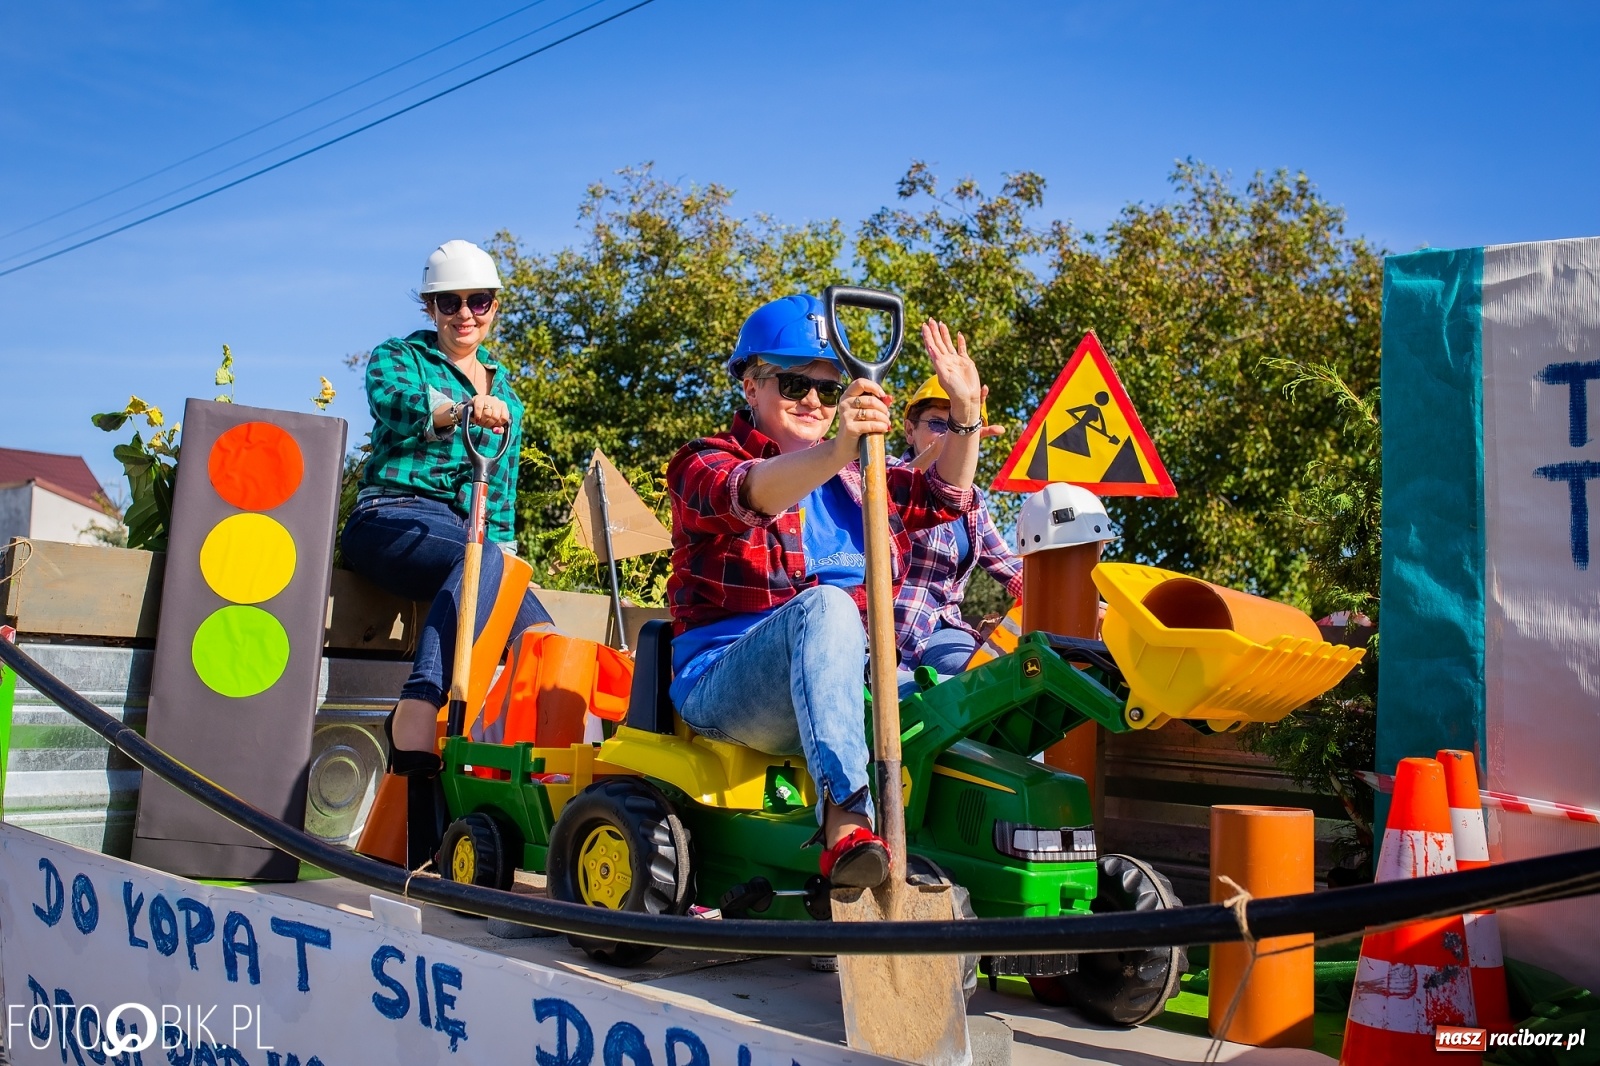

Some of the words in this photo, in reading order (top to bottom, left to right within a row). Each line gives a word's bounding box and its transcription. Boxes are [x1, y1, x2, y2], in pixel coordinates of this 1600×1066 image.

[32, 857, 99, 935] DO
[123, 879, 332, 992] ŁOPAT
[371, 945, 468, 1053] SIĘ
